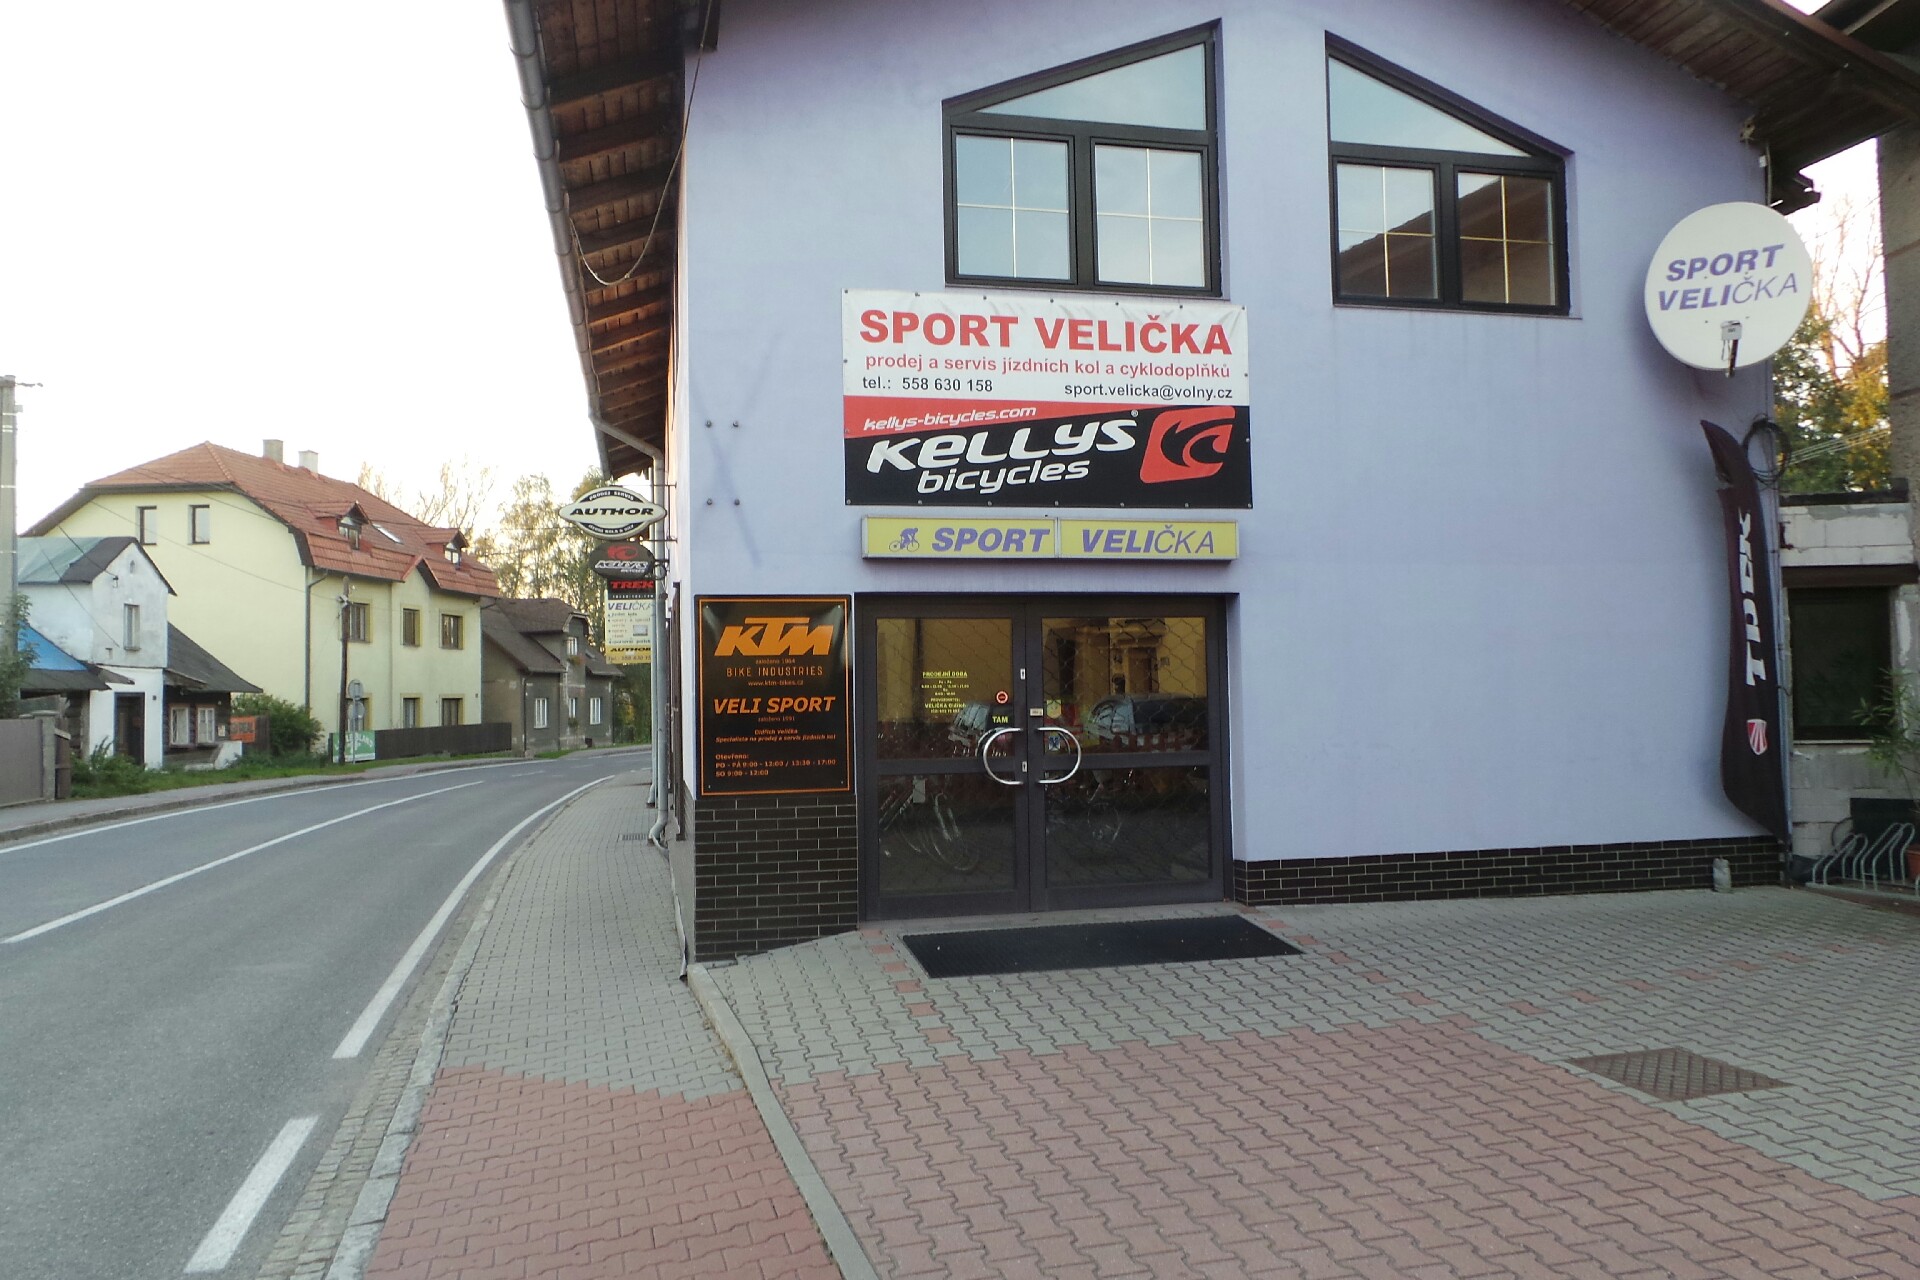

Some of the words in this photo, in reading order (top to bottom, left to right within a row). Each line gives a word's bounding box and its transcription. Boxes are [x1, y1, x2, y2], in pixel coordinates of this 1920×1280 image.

[1665, 243, 1784, 282] SPORT
[1658, 272, 1798, 311] VELIČKA
[860, 309, 1019, 348] SPORT
[1034, 314, 1233, 355] VELIČKA
[866, 354, 923, 372] prodej
[928, 358, 939, 369] a
[944, 356, 997, 371] servis
[1002, 357, 1069, 375] jízdních
[1075, 360, 1100, 374] kol
[1105, 363, 1115, 375] a
[1120, 362, 1231, 380] cyklodoplňků
[862, 376, 892, 390] tel.:
[902, 377, 929, 391] 558
[934, 378, 961, 391] 630
[966, 379, 993, 392] 158
[1064, 383, 1233, 401] sport.velicka@volny.cz
[863, 407, 1037, 432] kellys-bicycles.com
[917, 459, 1091, 494] bicycles
[569, 508, 654, 516] AUTHOR
[931, 527, 1051, 553] SPORT
[1082, 524, 1215, 554] VELIČKA
[610, 581, 654, 589] TREK
[714, 617, 834, 657] KTM
[726, 667, 752, 677] BIKE
[758, 666, 823, 677] INDUSTRIES
[713, 698, 762, 714] VELI
[766, 696, 836, 713] SPORT
[992, 716, 1009, 724] TAM
